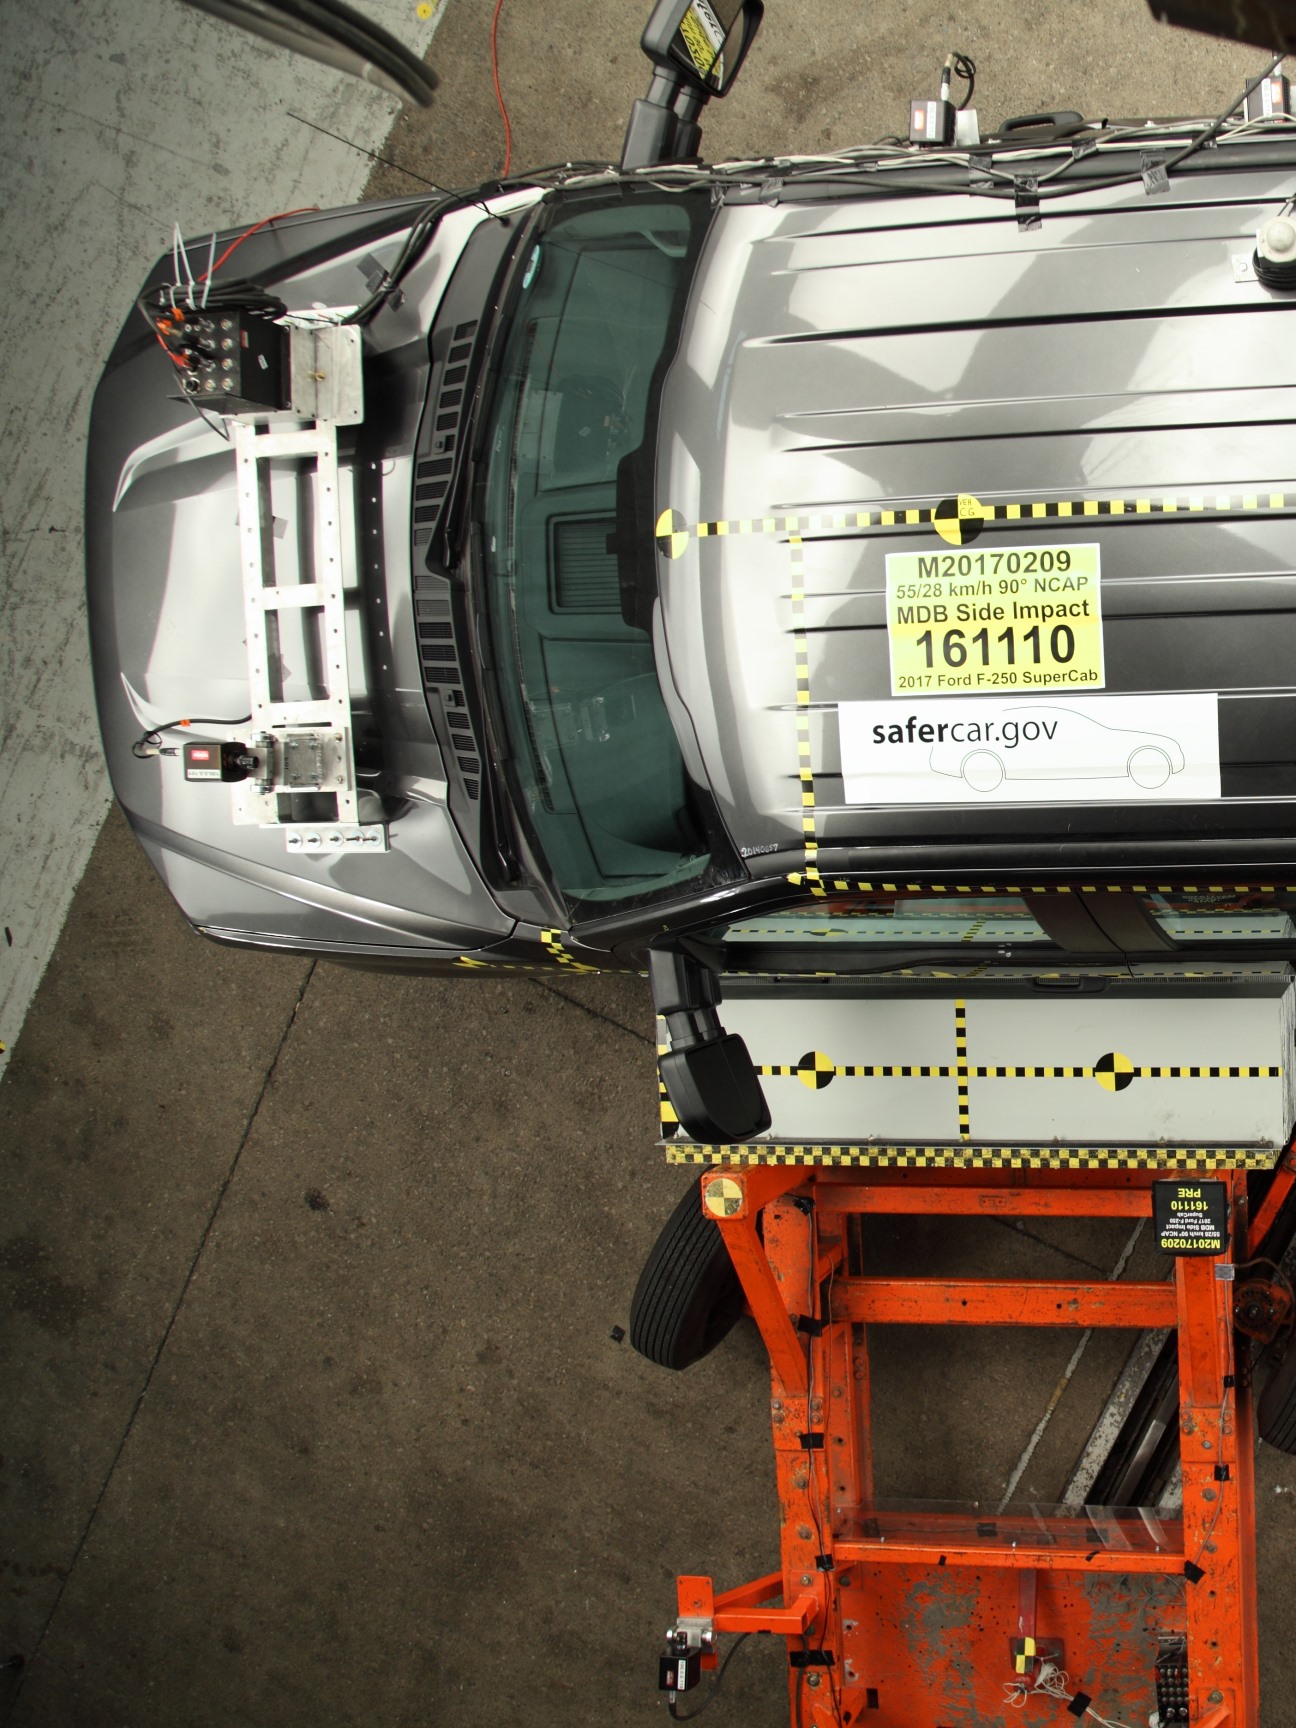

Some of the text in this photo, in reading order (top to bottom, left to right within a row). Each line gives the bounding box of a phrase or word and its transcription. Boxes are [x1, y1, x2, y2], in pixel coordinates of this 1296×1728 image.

[917, 550, 1072, 579] M20170209
[896, 576, 1089, 600] 55/28 km/h 90° NCAP
[897, 599, 1090, 624] MDB Side Impact
[916, 624, 1075, 669] 161110
[899, 669, 1099, 689] 2017 Ford F-250 SuperCab
[872, 716, 1058, 749] safercar.gov
[1178, 1188, 1201, 1198] PRE
[1170, 1201, 1208, 1210] 161110
[1160, 1238, 1220, 1248] M20170209
